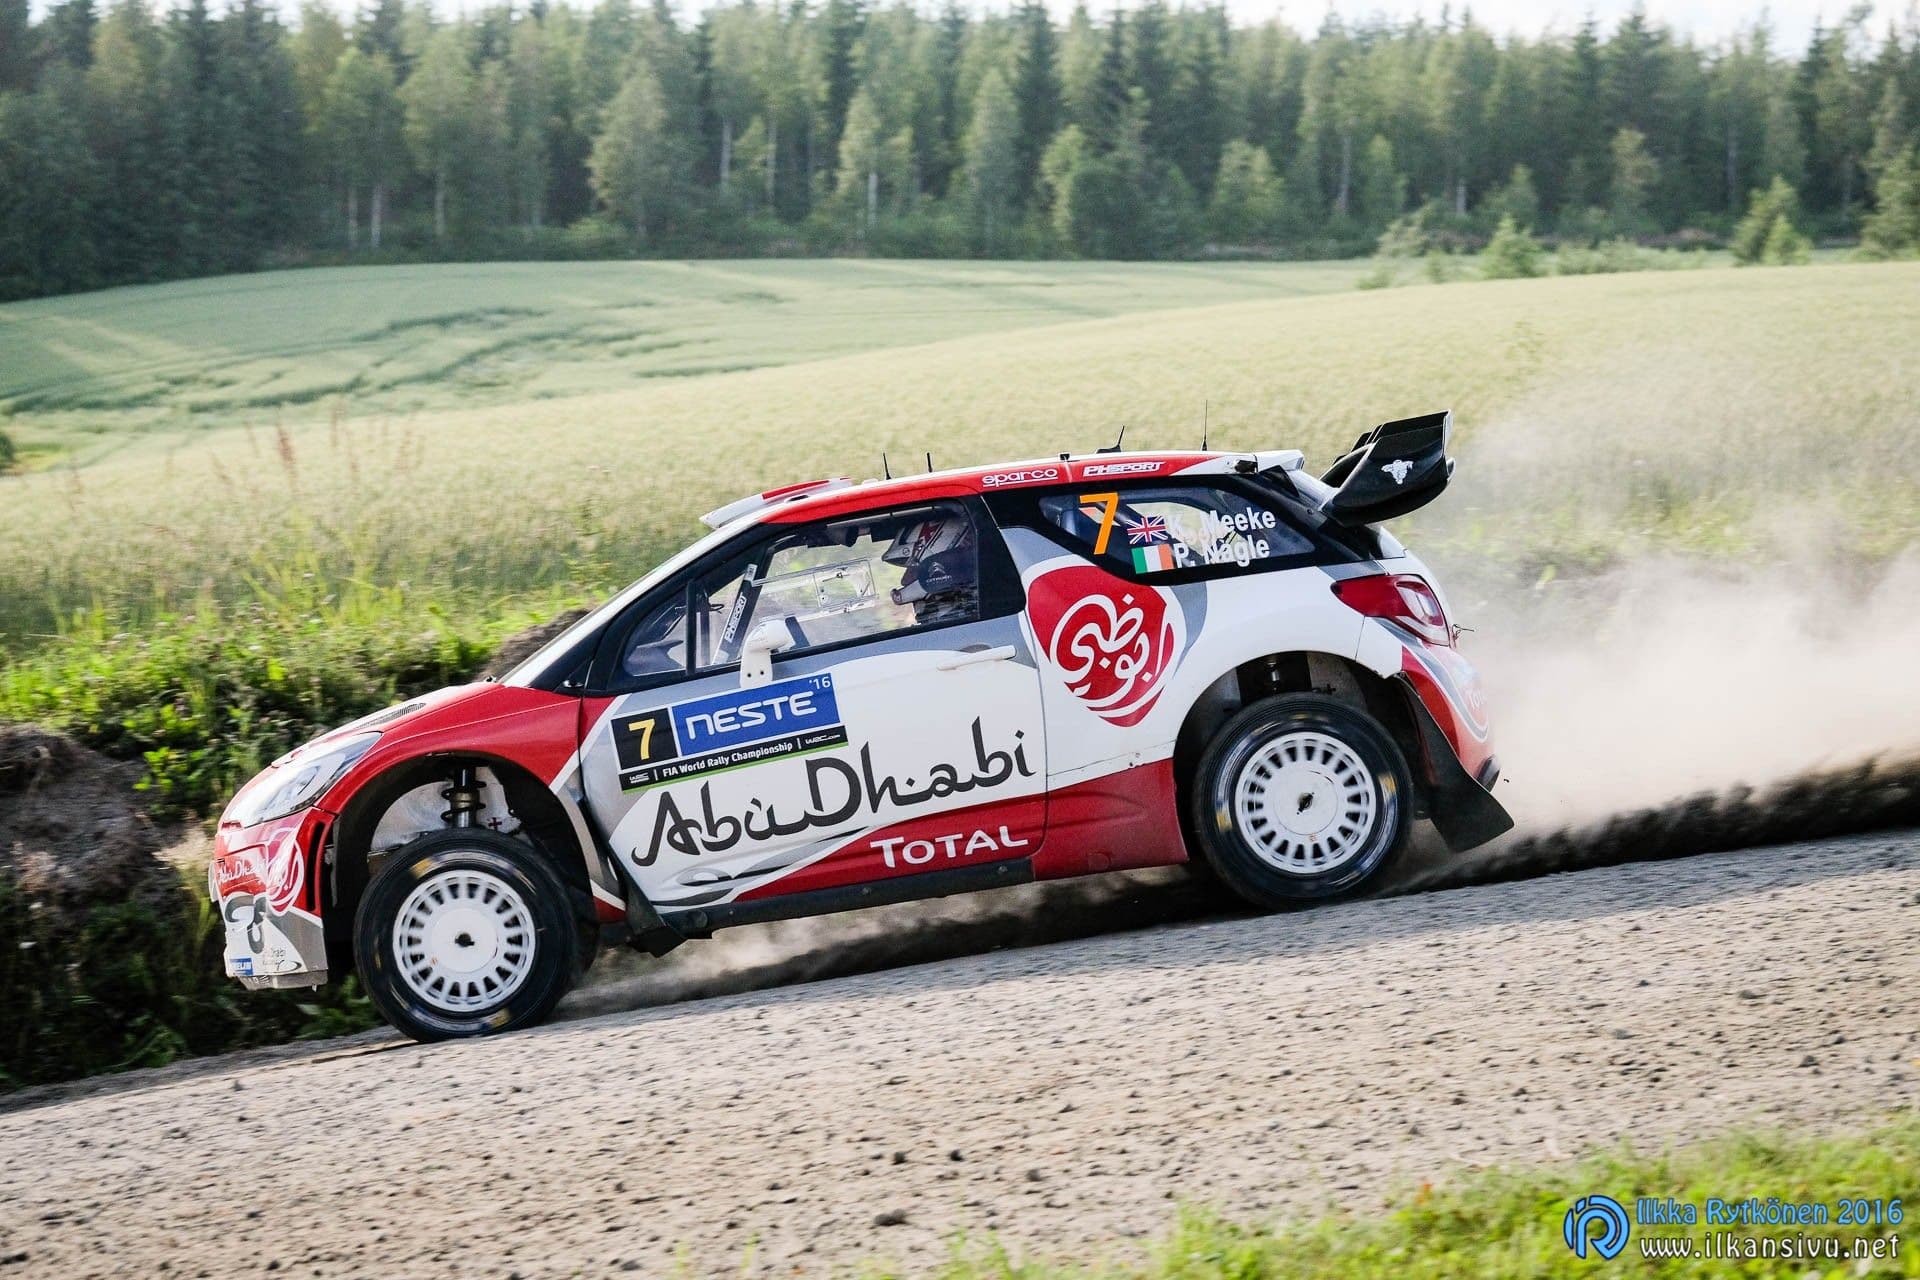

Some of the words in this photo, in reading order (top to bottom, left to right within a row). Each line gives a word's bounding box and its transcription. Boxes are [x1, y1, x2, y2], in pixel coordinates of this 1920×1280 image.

[982, 468, 1058, 487] sparco
[1083, 461, 1166, 477] PHSPORT
[1080, 492, 1119, 555] 7
[1201, 506, 1276, 540] Meeke
[1173, 542, 1196, 569] P.
[1202, 534, 1270, 568] Nagle
[685, 691, 817, 740] NESTE
[628, 718, 656, 761] 7
[662, 766, 679, 778] FIA
[678, 760, 706, 775] World
[707, 755, 731, 771] Rally
[731, 741, 794, 762] Championship
